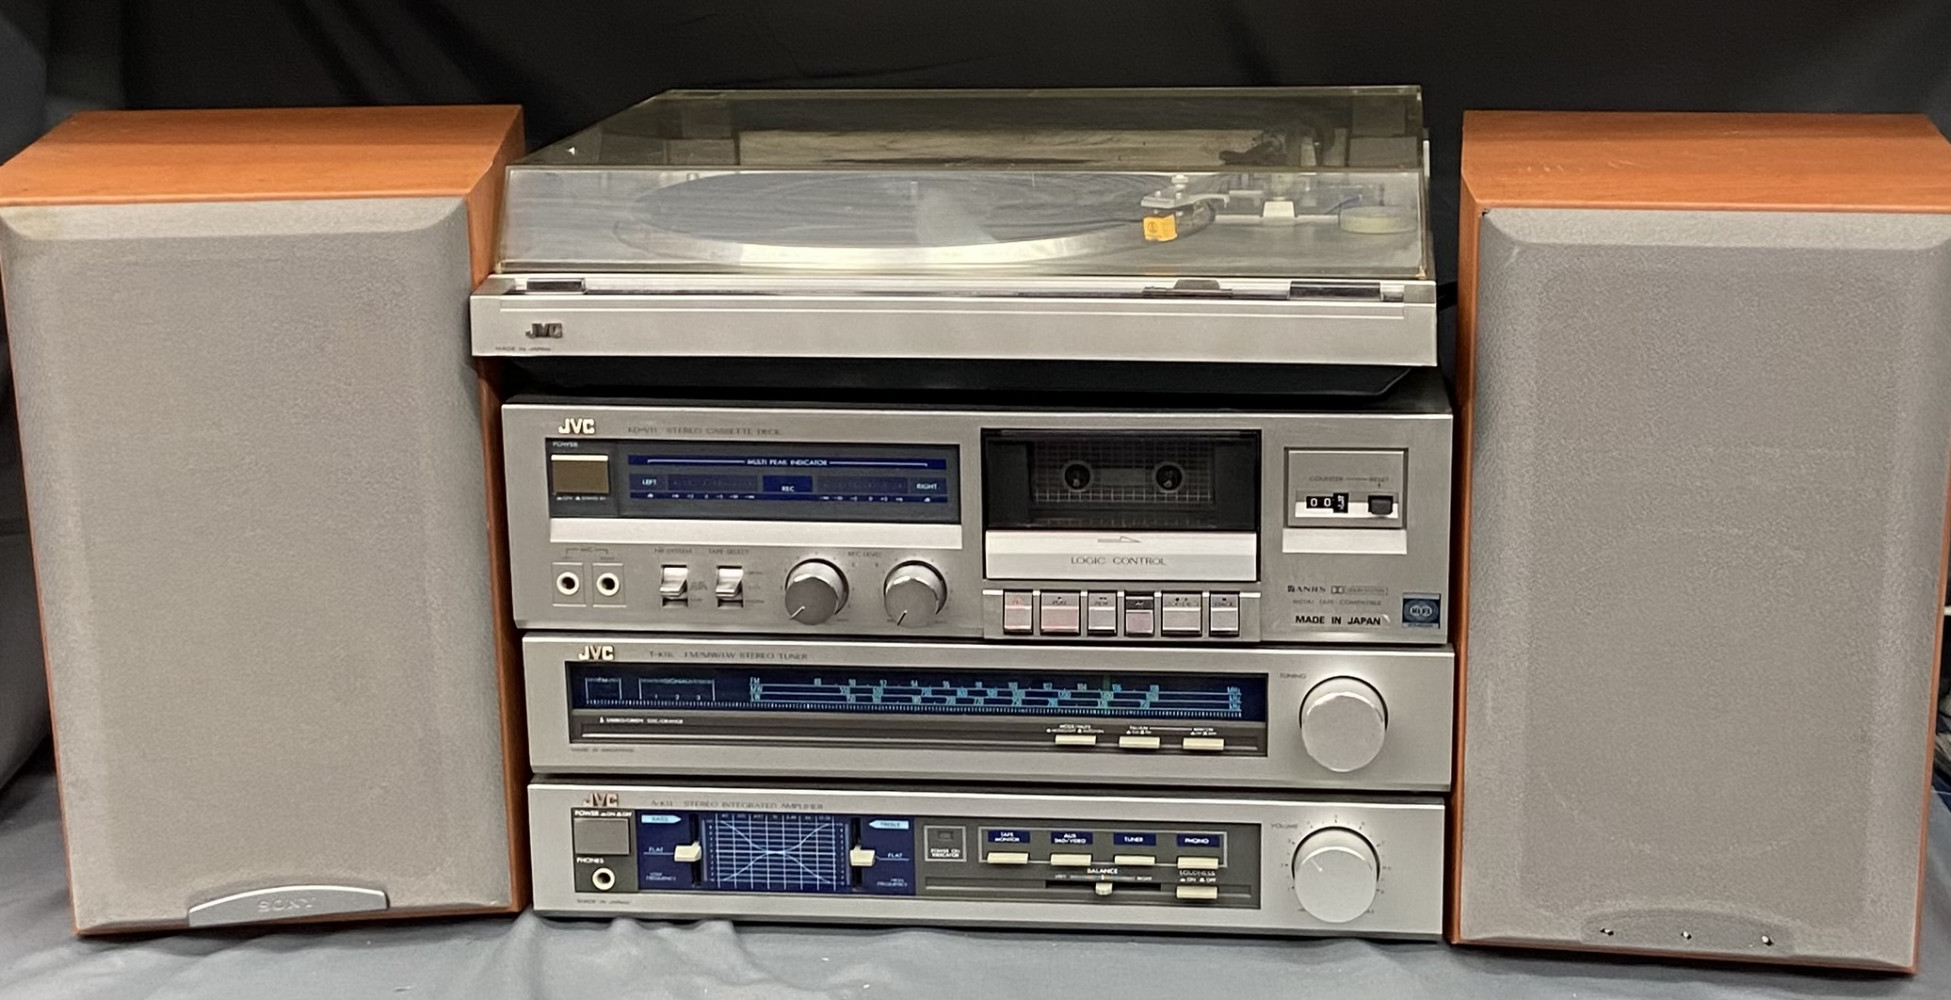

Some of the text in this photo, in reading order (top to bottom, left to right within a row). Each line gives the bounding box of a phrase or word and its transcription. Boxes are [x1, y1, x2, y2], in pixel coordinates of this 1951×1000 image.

[525, 323, 563, 339] JVC
[558, 418, 596, 434] JVC
[790, 459, 828, 467] INDICATOR
[1070, 556, 1166, 566] LOGIC CONTROL
[1295, 615, 1381, 625] MADE IN JAPAN
[578, 645, 614, 661] JVC
[739, 652, 774, 660] STEREO
[582, 793, 619, 807] JVC
[683, 800, 718, 808] STEREO
[721, 801, 777, 809] INTEGRATED
[781, 802, 824, 810] AMPLIFIER
[574, 810, 599, 818] POWER
[1184, 837, 1210, 845] PHONO
[1179, 869, 1216, 877] LOUDNESS
